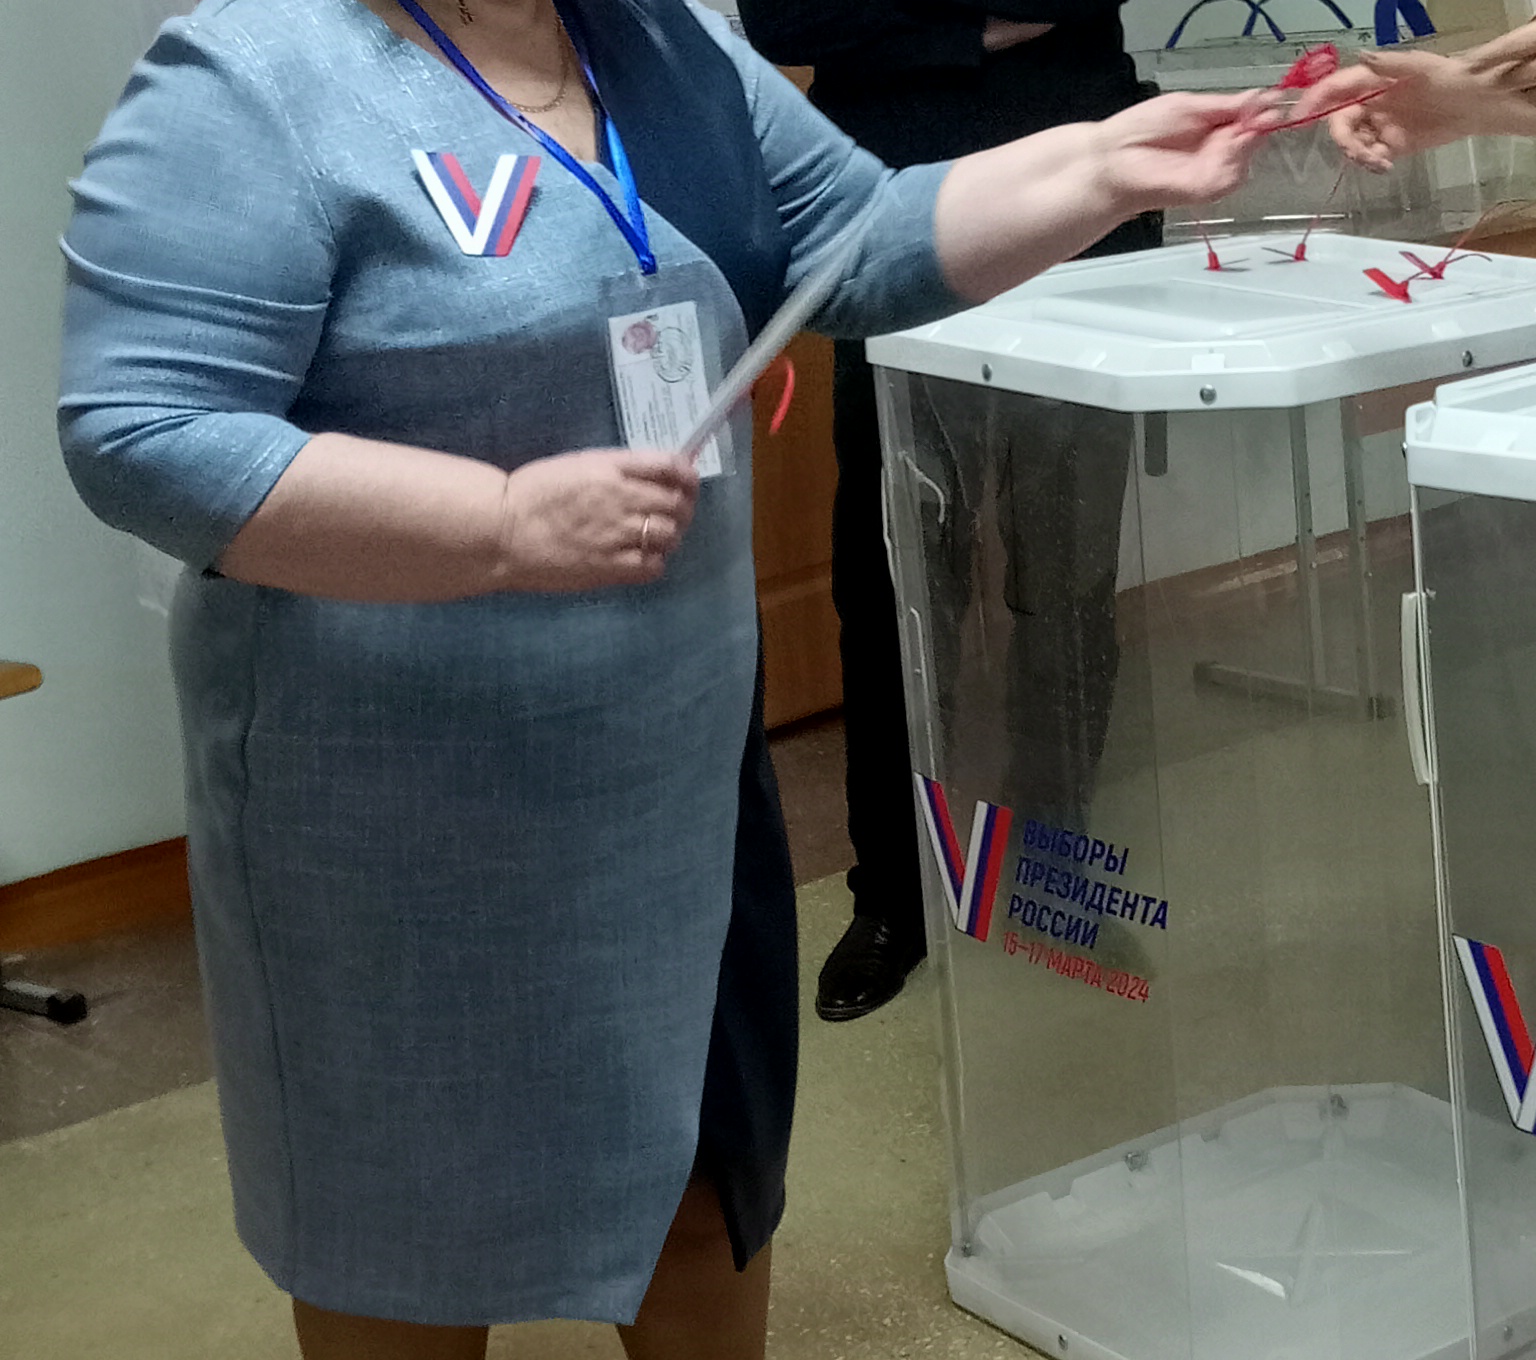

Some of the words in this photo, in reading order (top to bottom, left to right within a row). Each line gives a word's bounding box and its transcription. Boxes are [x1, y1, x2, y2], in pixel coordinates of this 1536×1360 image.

[1023, 819, 1130, 876] ВЫБОРЫ
[1008, 893, 1100, 950] РОССИИ
[1015, 856, 1169, 930] ПРЕЗИДЕНТА
[1046, 947, 1103, 989] МАРТА
[1106, 970, 1150, 1003] 2024
